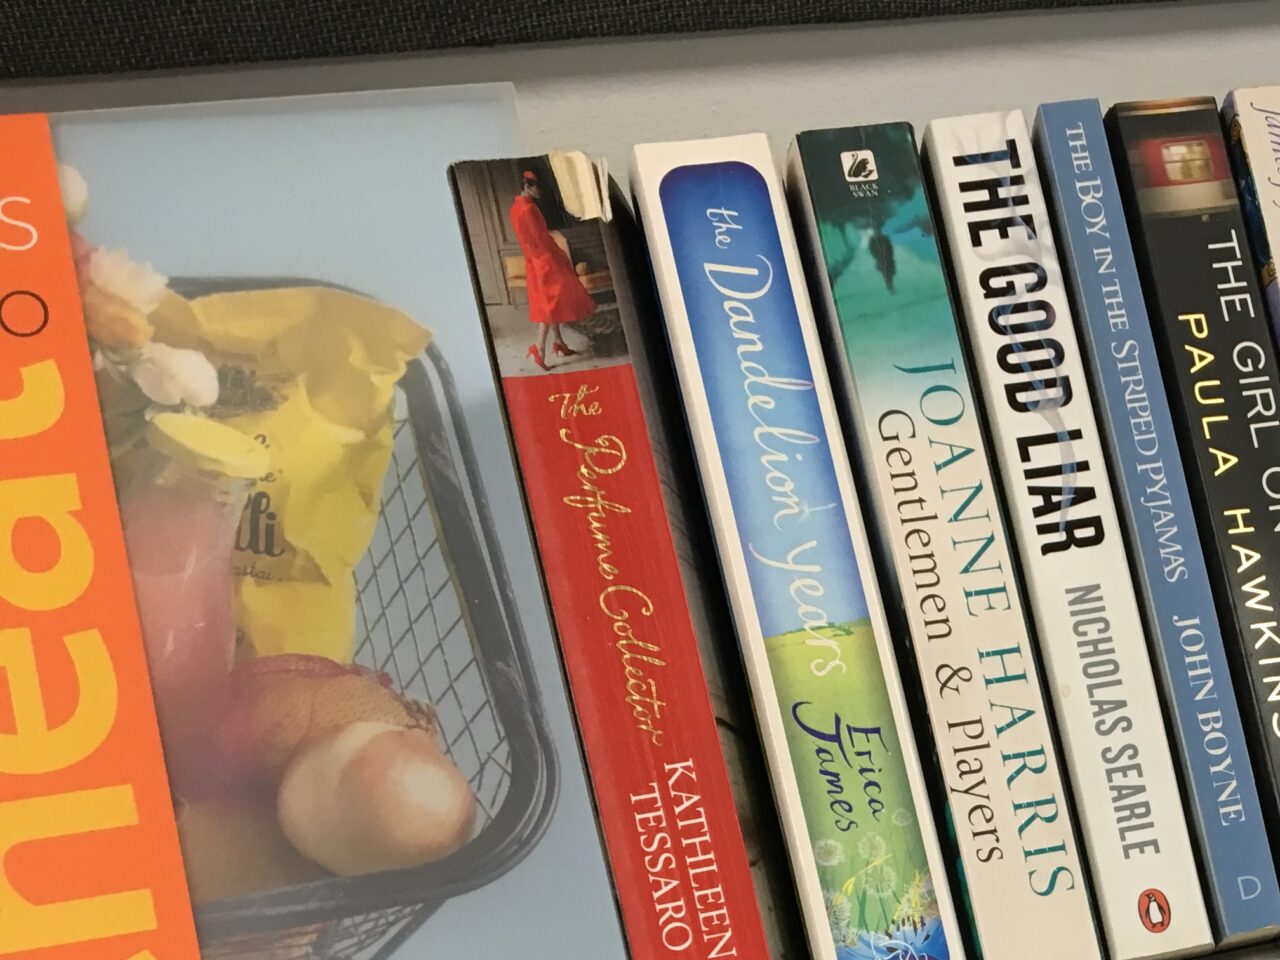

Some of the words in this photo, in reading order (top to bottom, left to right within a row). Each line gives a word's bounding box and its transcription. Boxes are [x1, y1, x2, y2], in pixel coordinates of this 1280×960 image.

[849, 182, 879, 193] BLACK
[851, 190, 879, 199] SWAN
[952, 138, 1037, 248] THE
[1065, 122, 1093, 174] THE
[1075, 176, 1111, 240] BOY
[706, 206, 743, 250] the
[1093, 247, 1117, 275] IN
[979, 262, 1073, 413] GOOD
[1101, 279, 1129, 332] THE
[1208, 229, 1255, 322] THE
[1233, 341, 1280, 448] GIRL
[548, 384, 603, 420] The
[703, 254, 837, 532] Dandelion
[1110, 339, 1160, 456] STRIPED
[1178, 313, 1239, 477] PAULA
[560, 428, 632, 580] Perfume
[878, 409, 953, 643] Gentlemen
[1016, 428, 1105, 556] LIAR
[1136, 459, 1188, 583] PYJAMAS
[600, 585, 667, 746] Collector
[749, 540, 846, 677] years
[893, 357, 1012, 617] JOANNE
[978, 641, 1076, 897] HARRIS
[1064, 583, 1133, 737] NICHOLAS
[1172, 614, 1218, 700] JOHN
[935, 663, 973, 698] &
[791, 700, 858, 833] James
[846, 723, 892, 823] Erica
[946, 715, 1004, 863] Players
[1101, 743, 1161, 859] SEARLE
[1196, 707, 1246, 826] BOYNE
[630, 782, 693, 952] TESSARO
[664, 758, 738, 959] KATHLEEN
